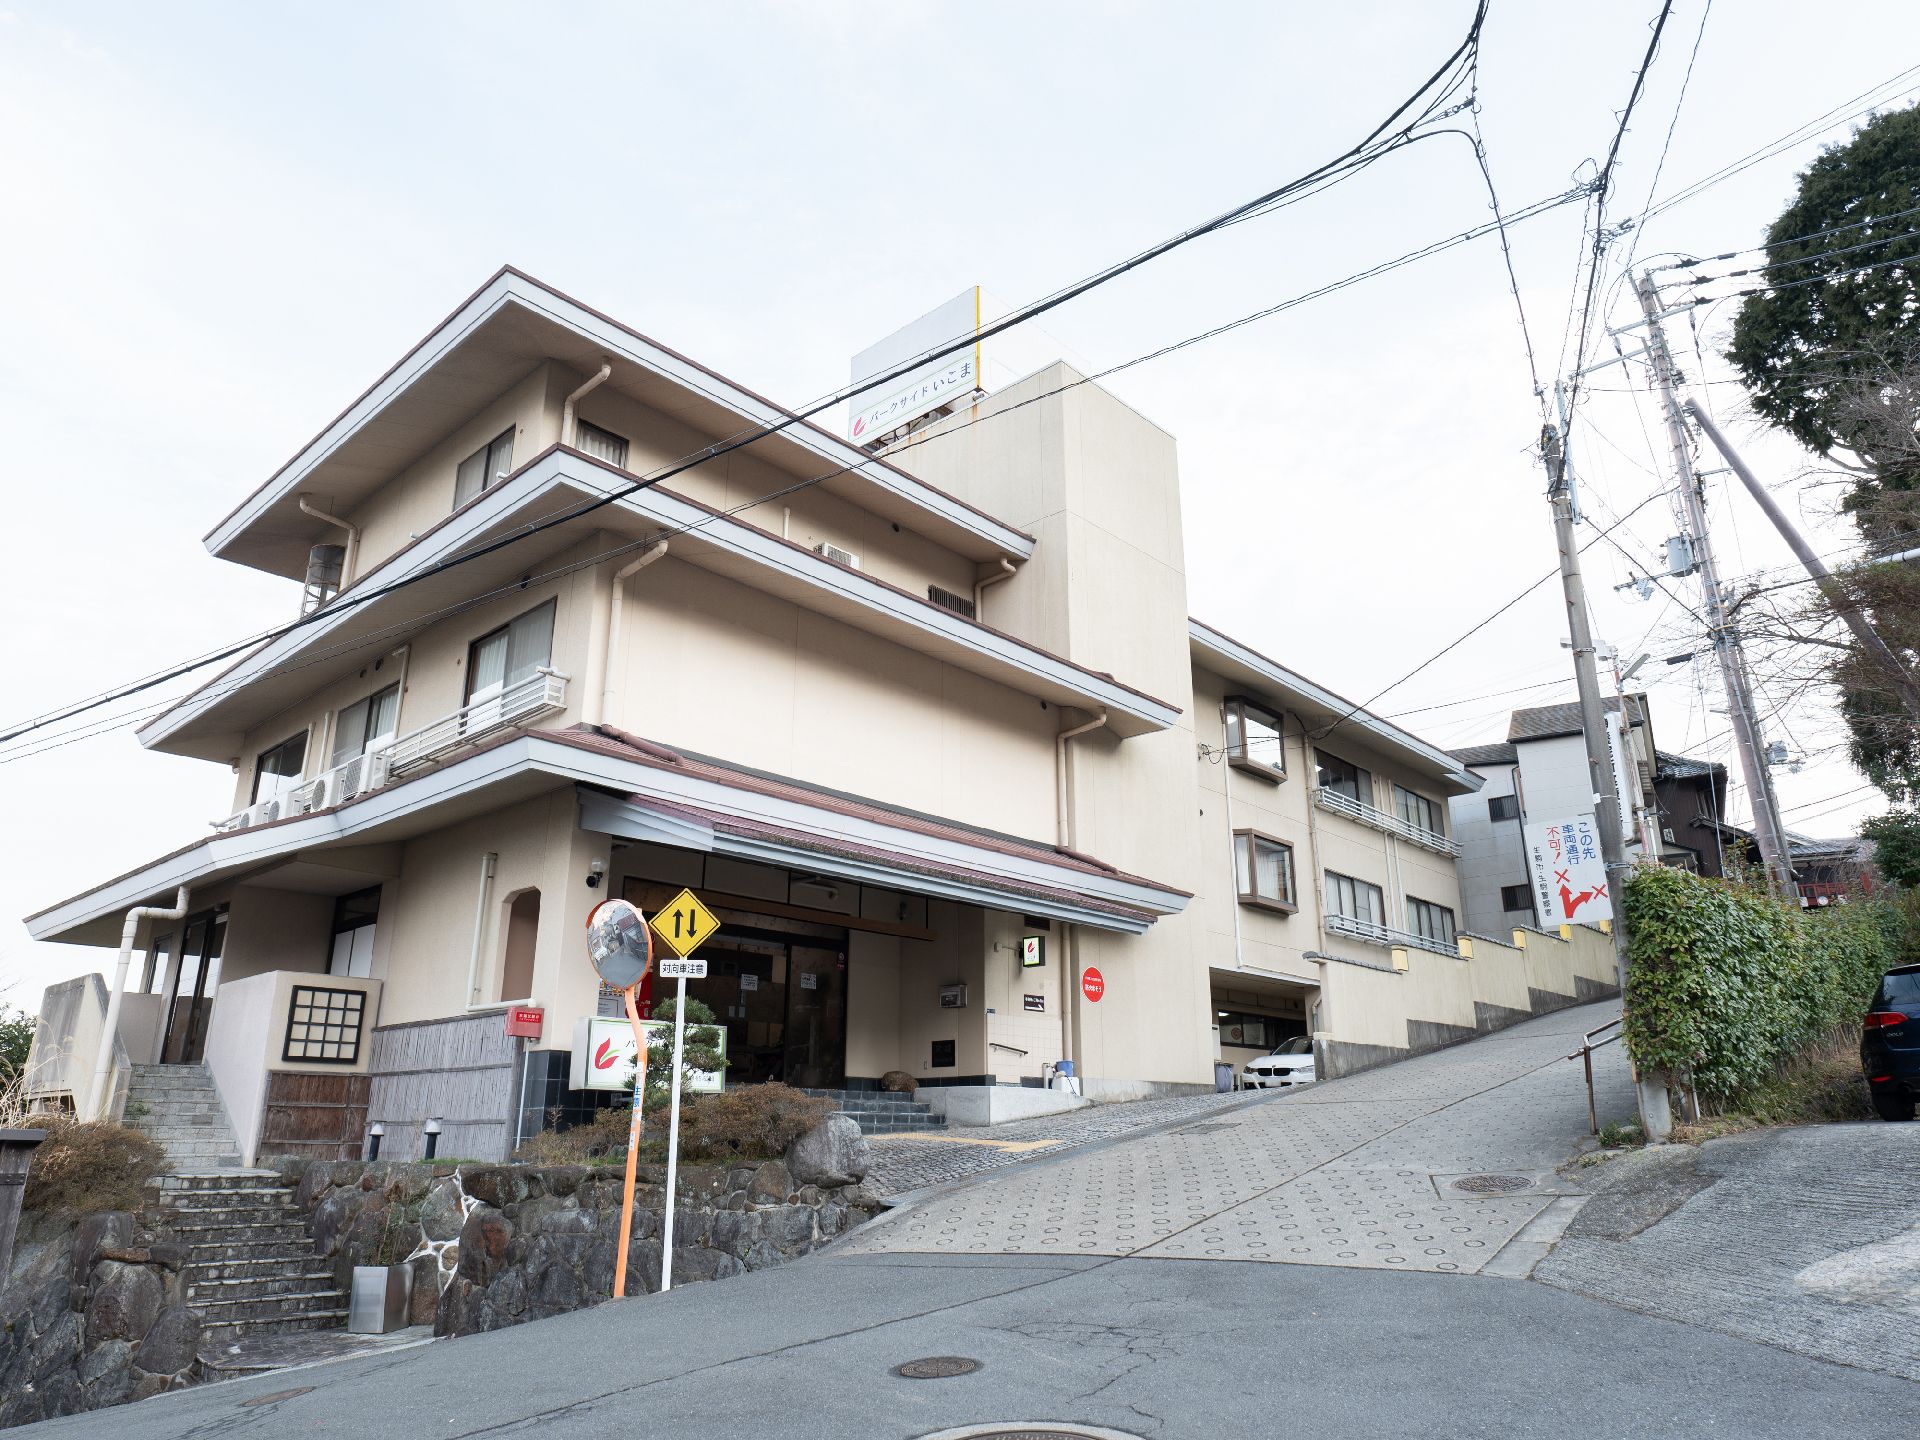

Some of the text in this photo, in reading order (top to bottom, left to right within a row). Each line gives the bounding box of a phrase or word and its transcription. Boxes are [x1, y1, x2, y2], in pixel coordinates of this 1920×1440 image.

[1561, 824, 1581, 866] 車両通行
[1579, 822, 1596, 860] この先
[662, 963, 705, 975] 対向車注意
